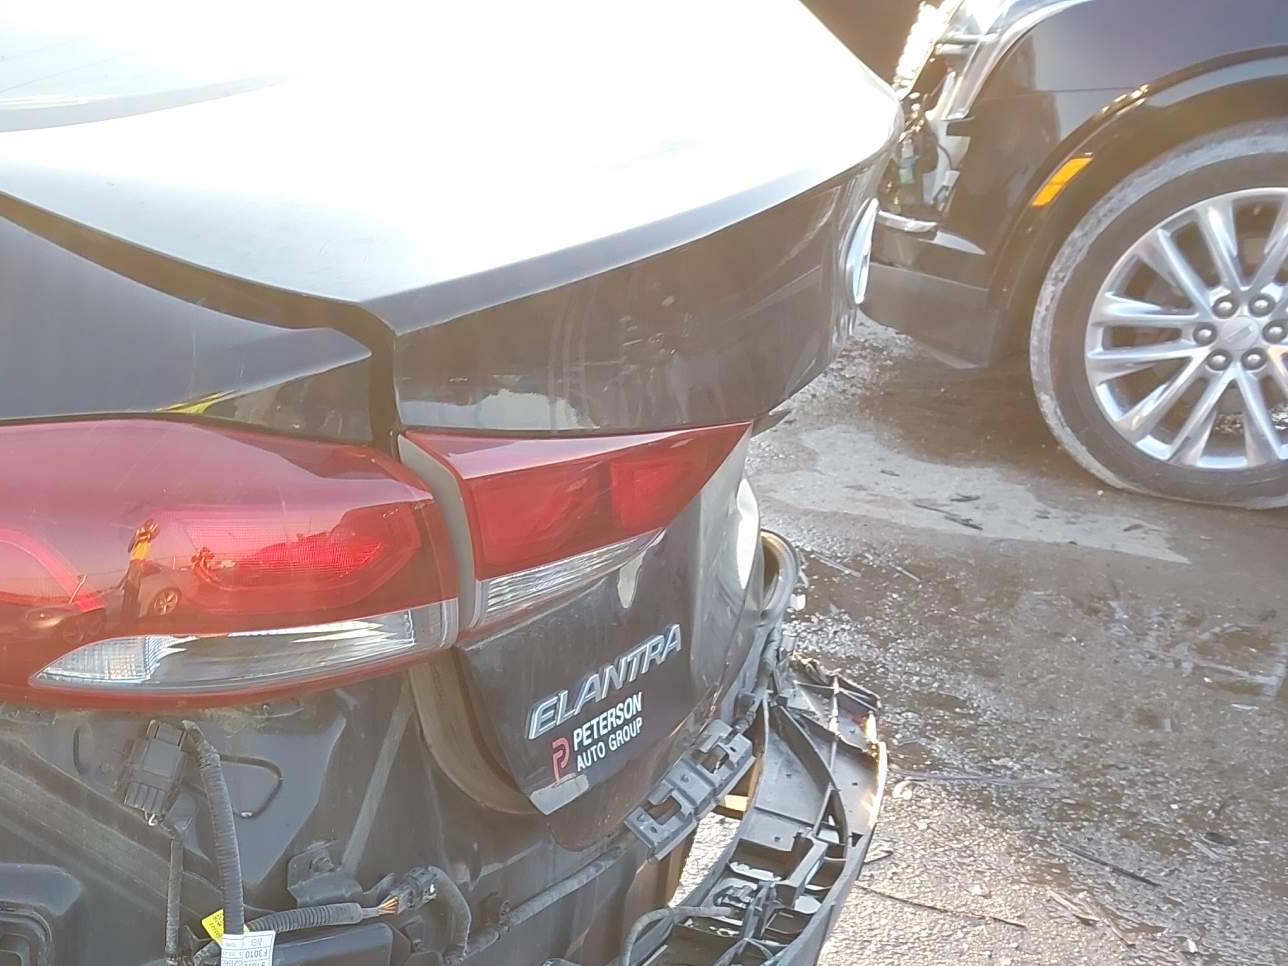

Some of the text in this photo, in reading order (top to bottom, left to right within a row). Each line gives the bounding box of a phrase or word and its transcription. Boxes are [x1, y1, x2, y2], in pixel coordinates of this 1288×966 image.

[527, 624, 681, 740] ELANTRA
[573, 692, 643, 751] PETERSON
[577, 717, 643, 771] AUTO GROUP
